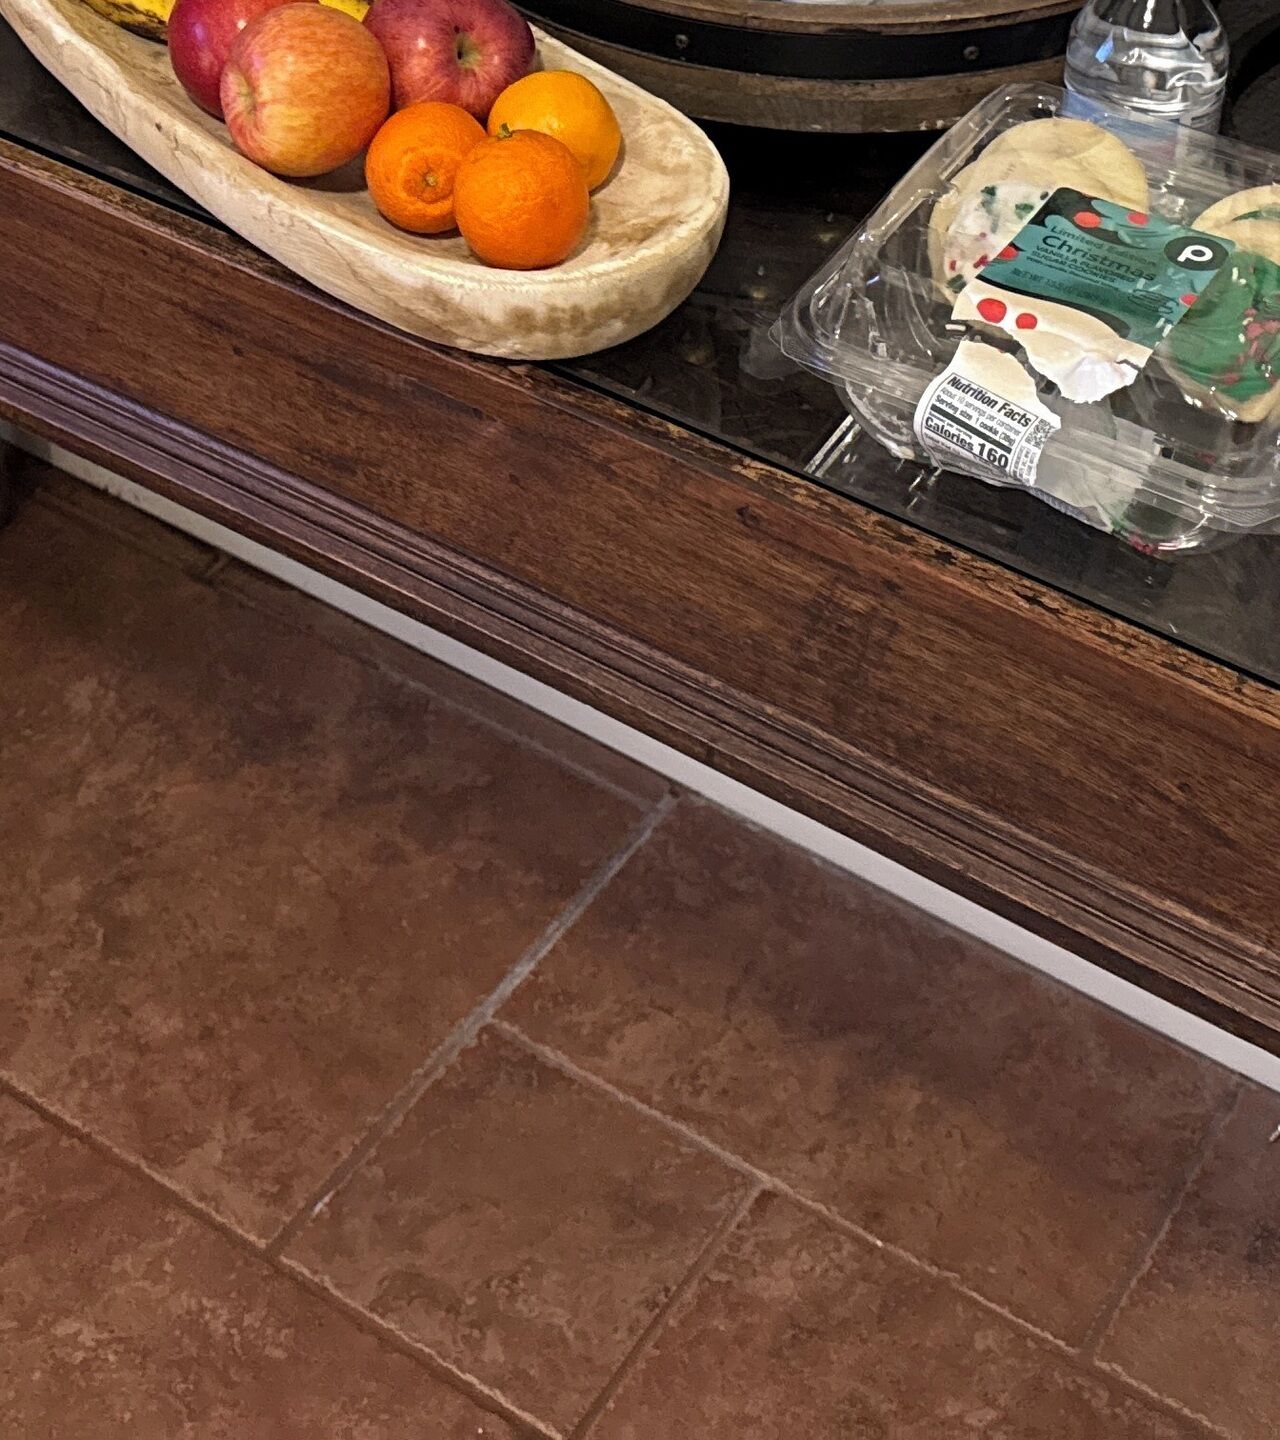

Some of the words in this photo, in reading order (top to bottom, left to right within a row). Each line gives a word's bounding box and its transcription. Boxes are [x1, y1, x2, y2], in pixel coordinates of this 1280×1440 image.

[1036, 245, 1078, 264] VANILLA
[1051, 225, 1105, 249] Limited
[1031, 250, 1067, 266] SUGAR
[1042, 235, 1157, 281] Christmas
[935, 394, 959, 414] Serving
[959, 409, 973, 421] size
[980, 421, 999, 437] cookie
[947, 376, 998, 409] Nutrition
[997, 402, 1032, 427] Facts
[964, 400, 986, 417] servings
[986, 412, 997, 421] per
[996, 418, 1021, 436] container
[925, 417, 974, 451] Calories
[978, 442, 1009, 469] 160
